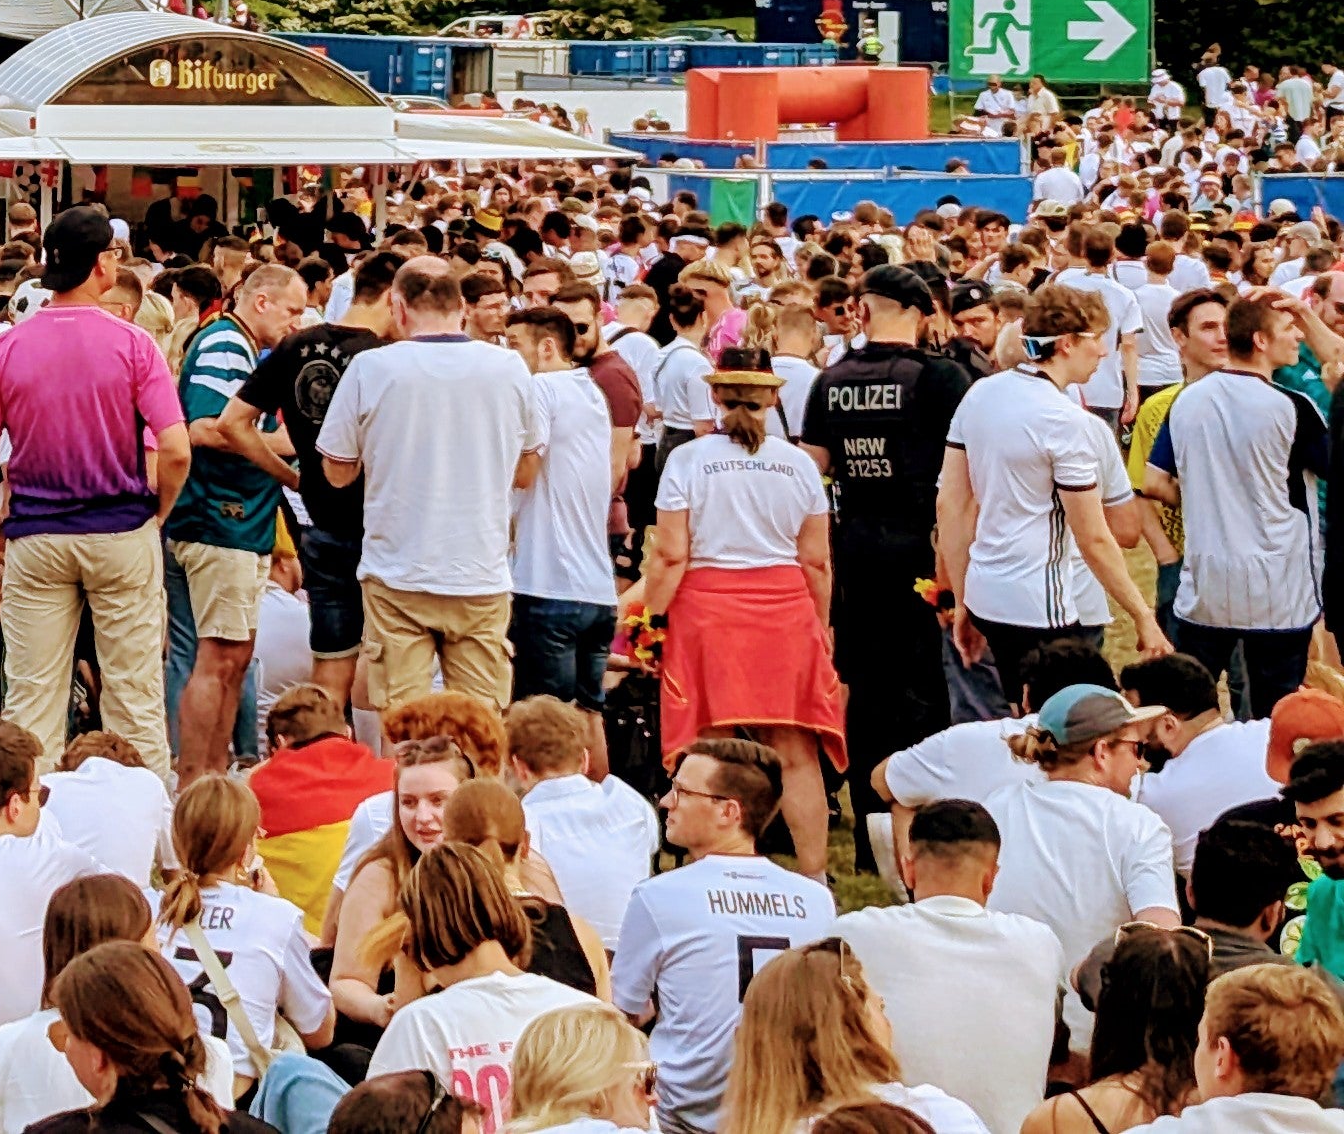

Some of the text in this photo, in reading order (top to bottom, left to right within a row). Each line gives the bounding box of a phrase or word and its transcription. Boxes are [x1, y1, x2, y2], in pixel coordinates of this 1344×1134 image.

[176, 58, 277, 95] Bitburger
[828, 384, 901, 411] POLIZEI
[844, 437, 886, 456] NRW
[703, 460, 794, 476] DEUTSCHLAND
[847, 459, 892, 477] 31253
[706, 889, 807, 919] HUMMELS
